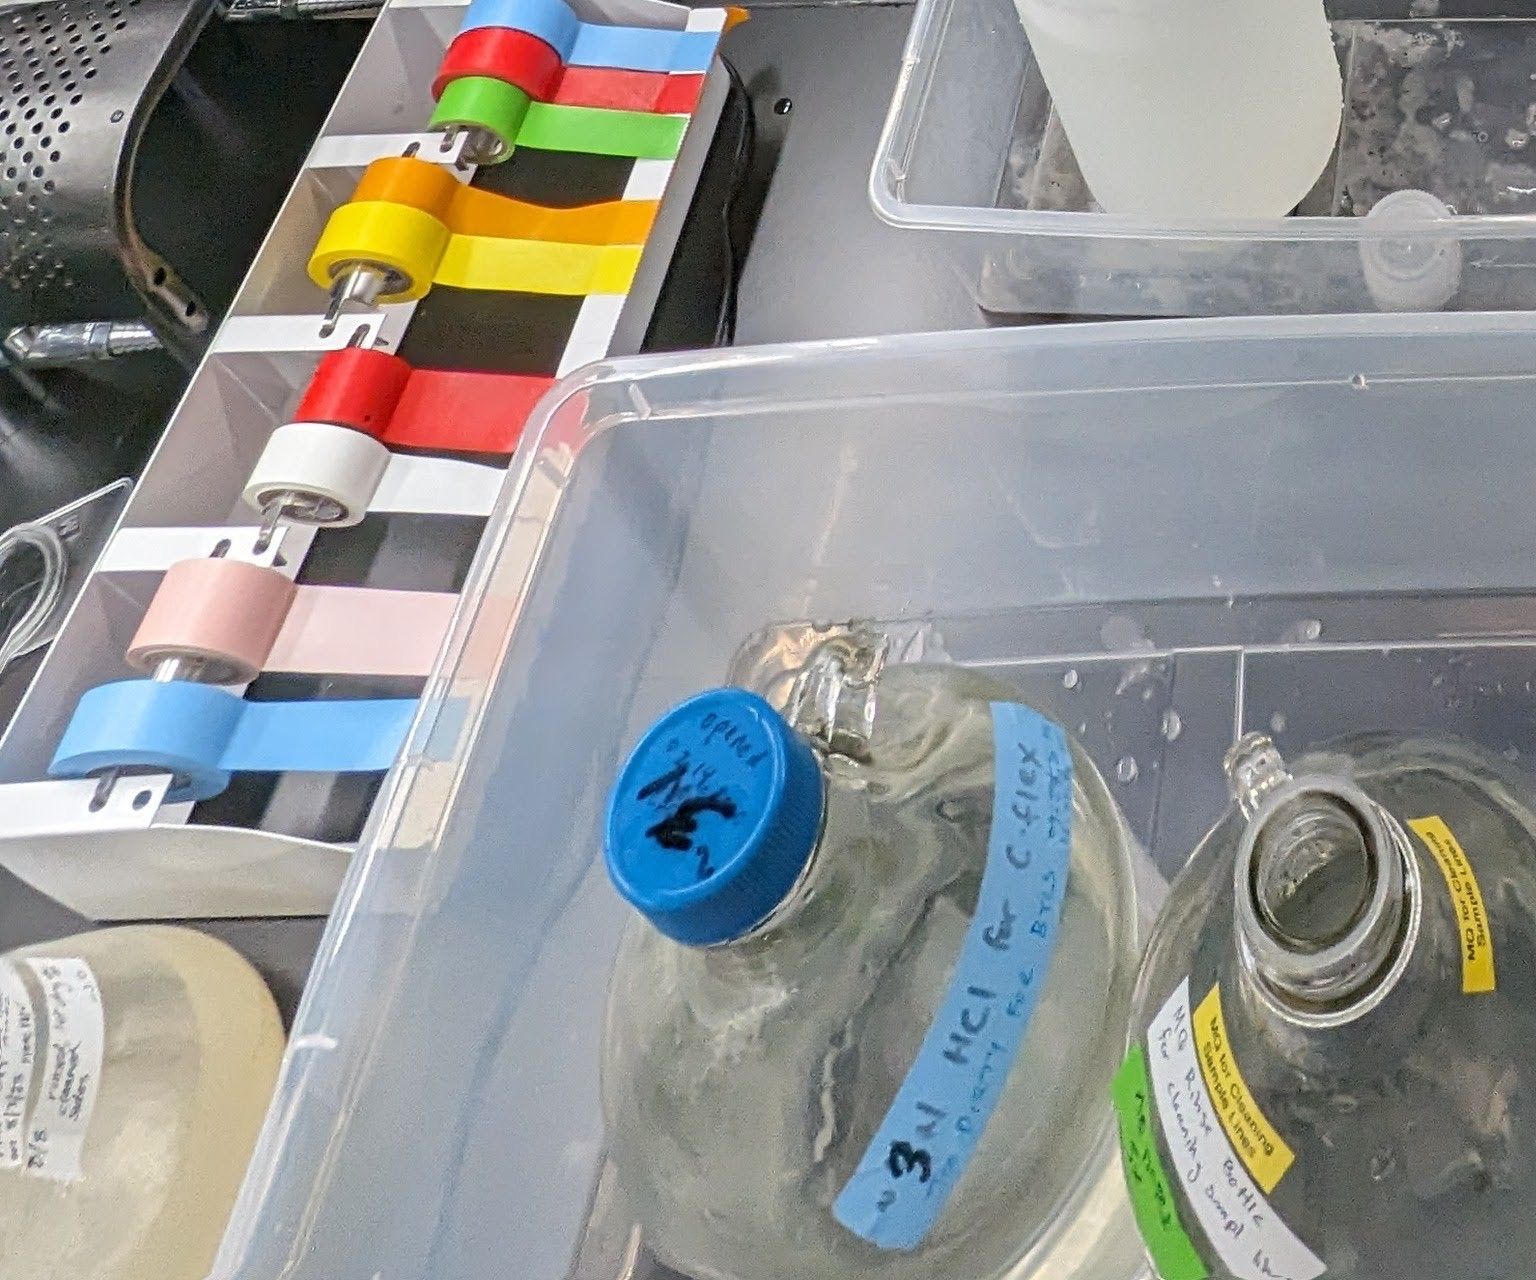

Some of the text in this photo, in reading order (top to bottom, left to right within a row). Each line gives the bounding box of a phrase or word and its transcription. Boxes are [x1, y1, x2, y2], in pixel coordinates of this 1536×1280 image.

[1425, 831, 1463, 893] Cleaning
[1445, 838, 1486, 948] Sample Lines
[982, 898, 1017, 952] for
[1460, 900, 1470, 922] for
[1203, 1041, 1256, 1159] Sample Lines
[1218, 1052, 1233, 1079] for
[1230, 1082, 1276, 1157] Cleaning
